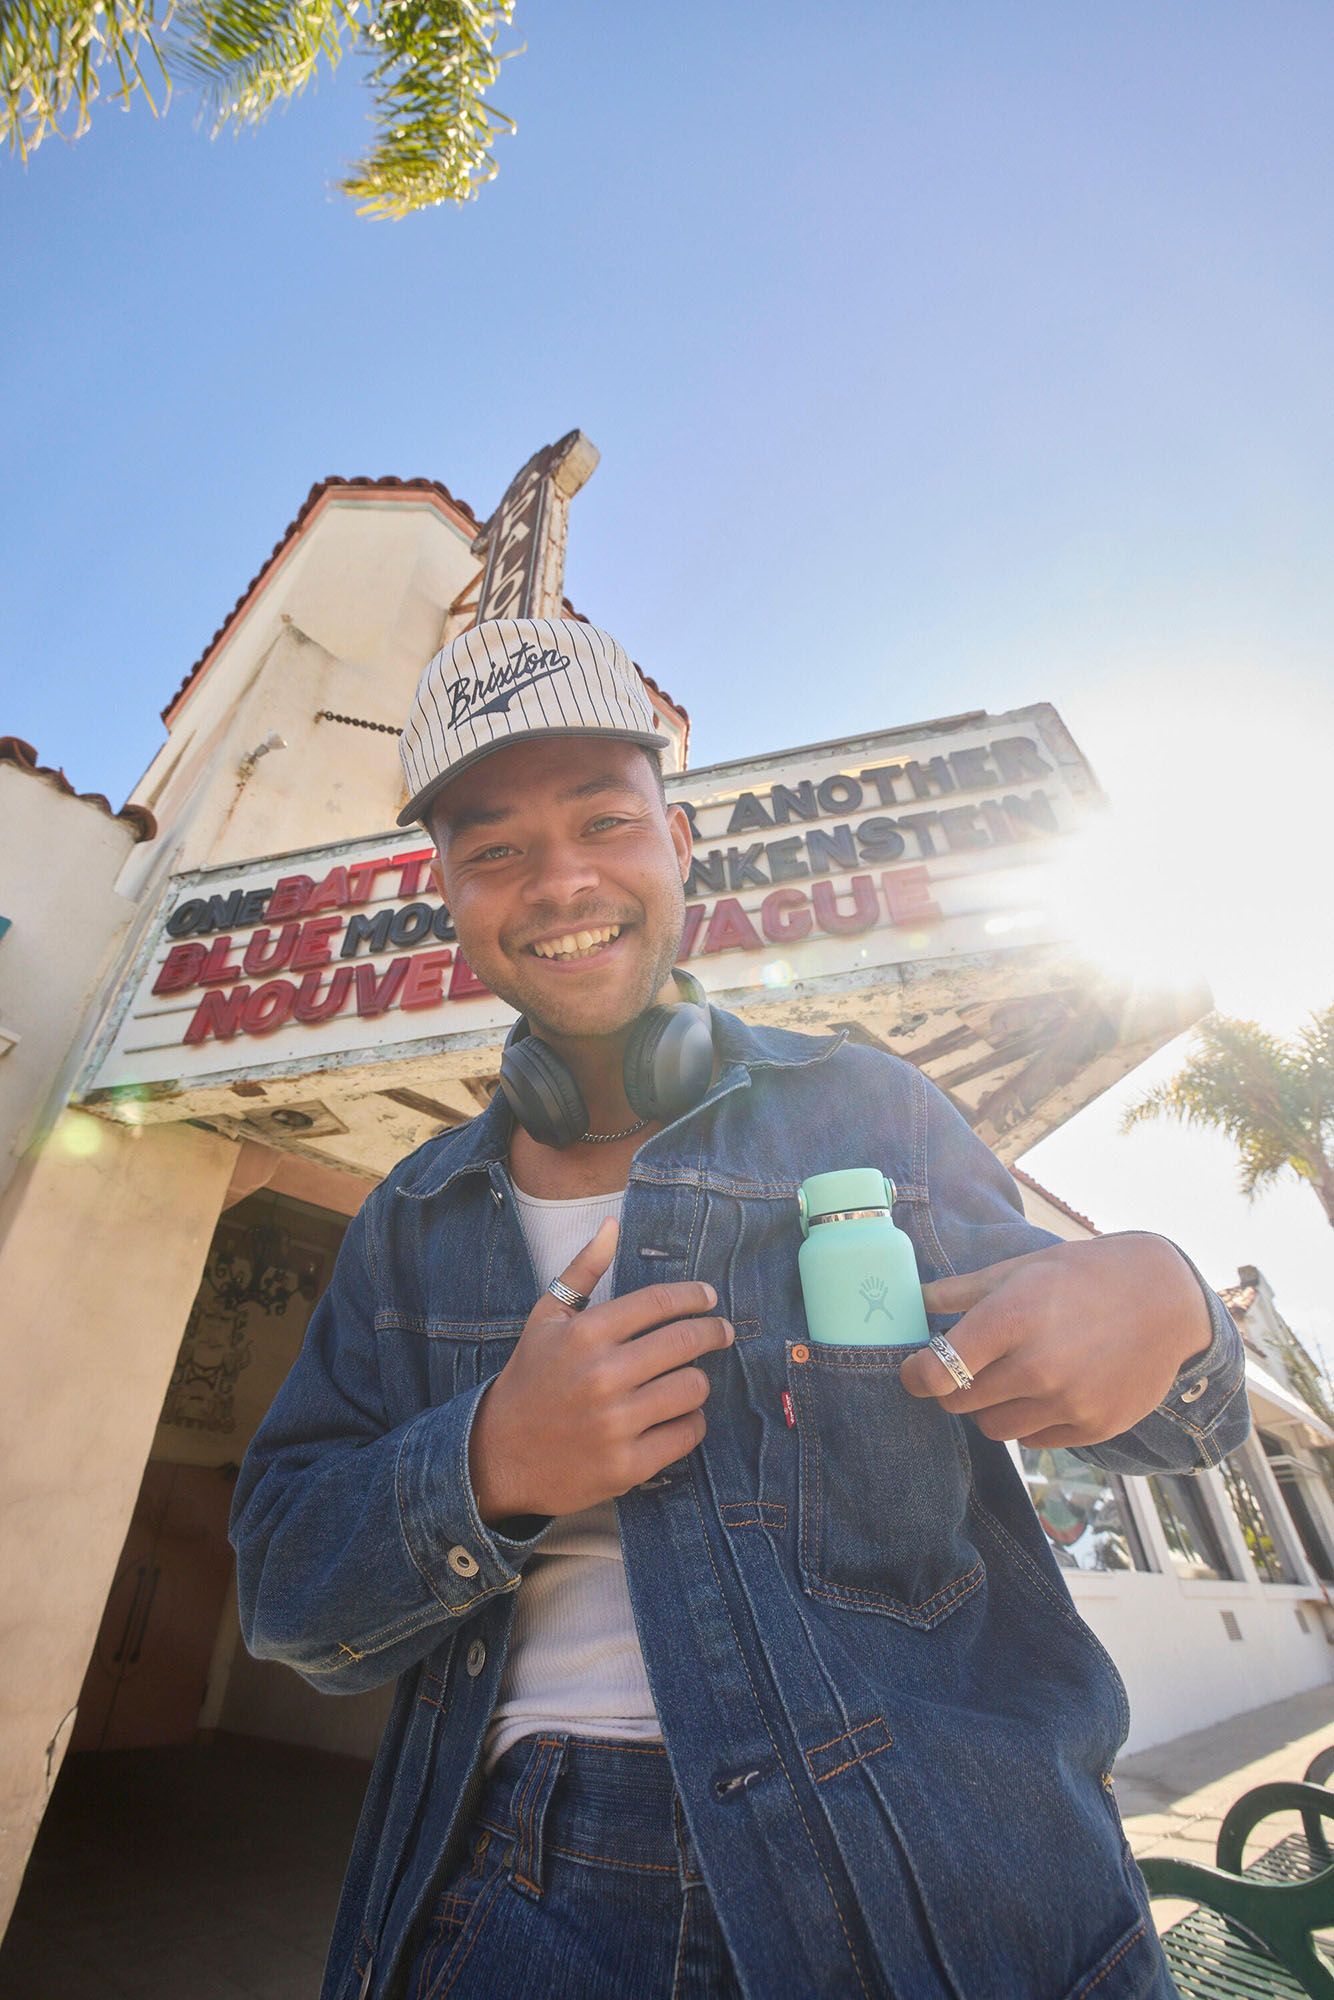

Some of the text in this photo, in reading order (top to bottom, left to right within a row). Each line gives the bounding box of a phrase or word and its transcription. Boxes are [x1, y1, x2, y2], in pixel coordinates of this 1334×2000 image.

[447, 641, 571, 730] Brixton
[726, 735, 1055, 834] ANOTHER
[165, 848, 440, 938] ONE BATT
[151, 914, 343, 996] BLUE
